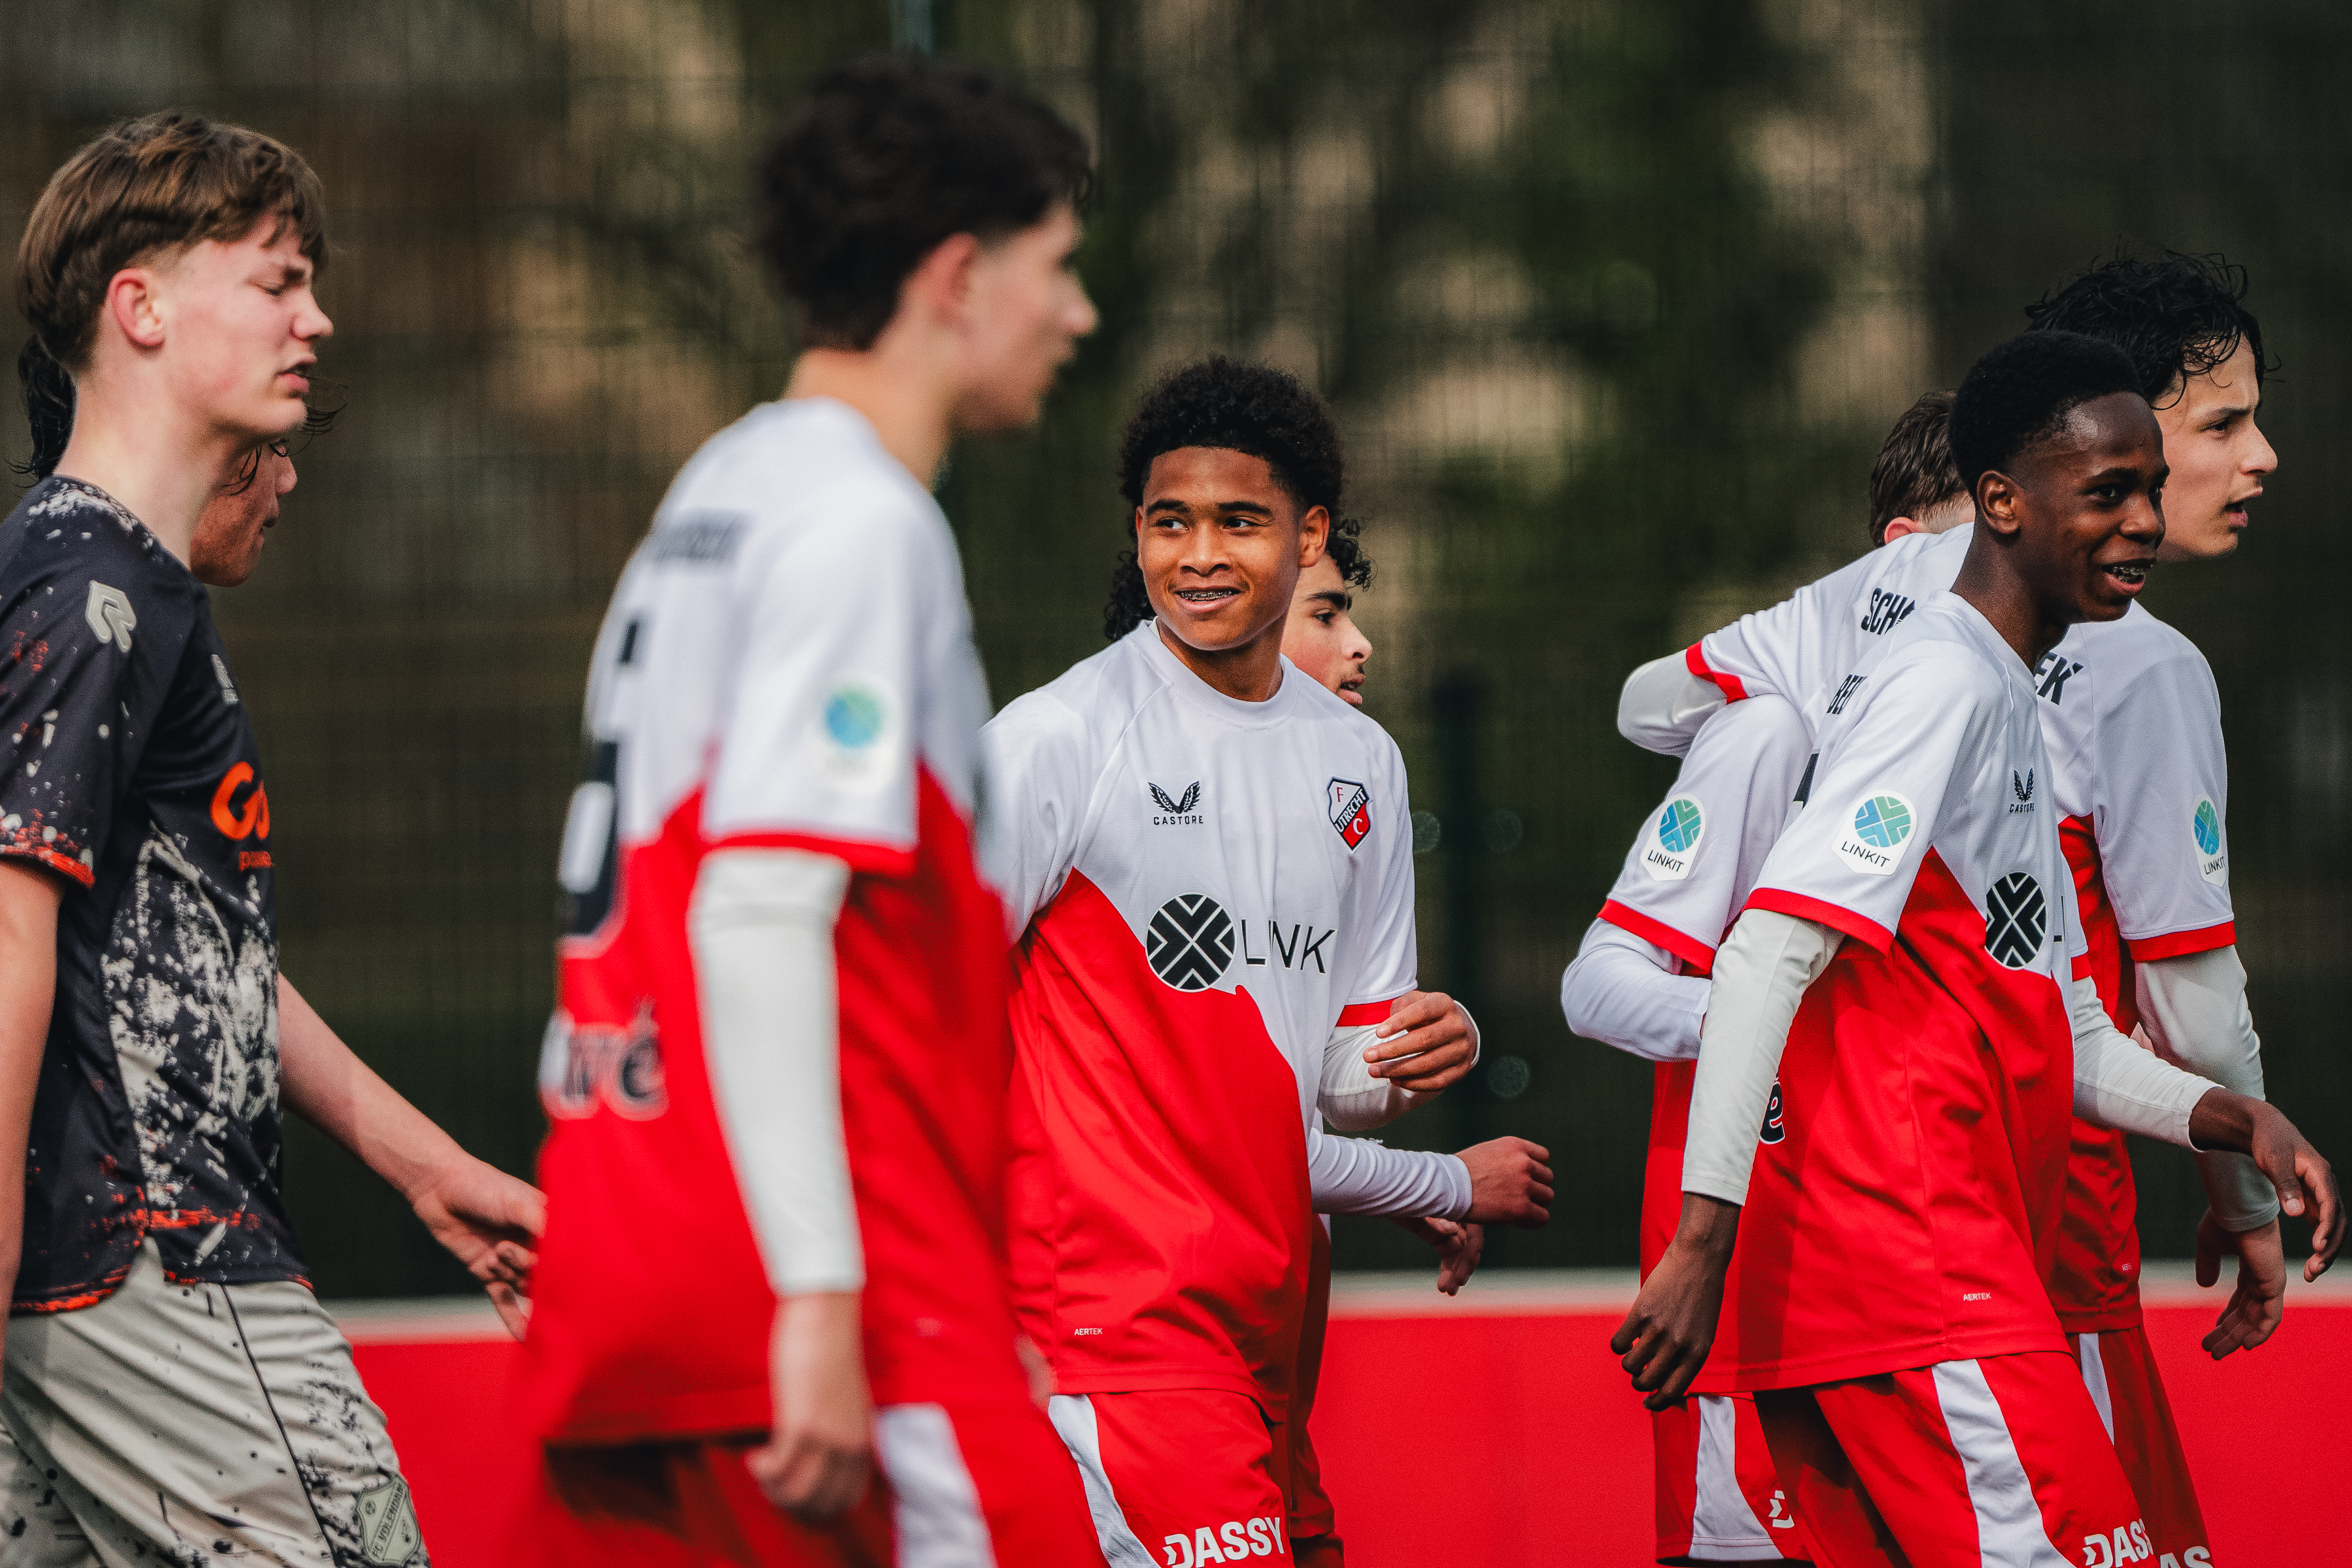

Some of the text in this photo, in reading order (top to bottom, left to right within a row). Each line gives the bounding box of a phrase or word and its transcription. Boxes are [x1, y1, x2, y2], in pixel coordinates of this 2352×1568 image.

[1336, 787, 1344, 802] F
[1335, 788, 1366, 833] UTRECHT
[2009, 803, 2035, 813] CASTORE
[1154, 815, 1204, 825] CASTORE
[1353, 818, 1364, 835] C
[1647, 850, 1684, 872] LINKIT
[1842, 841, 1890, 867] LINKIT
[2204, 856, 2225, 875] LINKIT
[1963, 1292, 1992, 1301] AERTEK
[1074, 1328, 1103, 1336] AERTEK
[1162, 1517, 1285, 1568] DASSY
